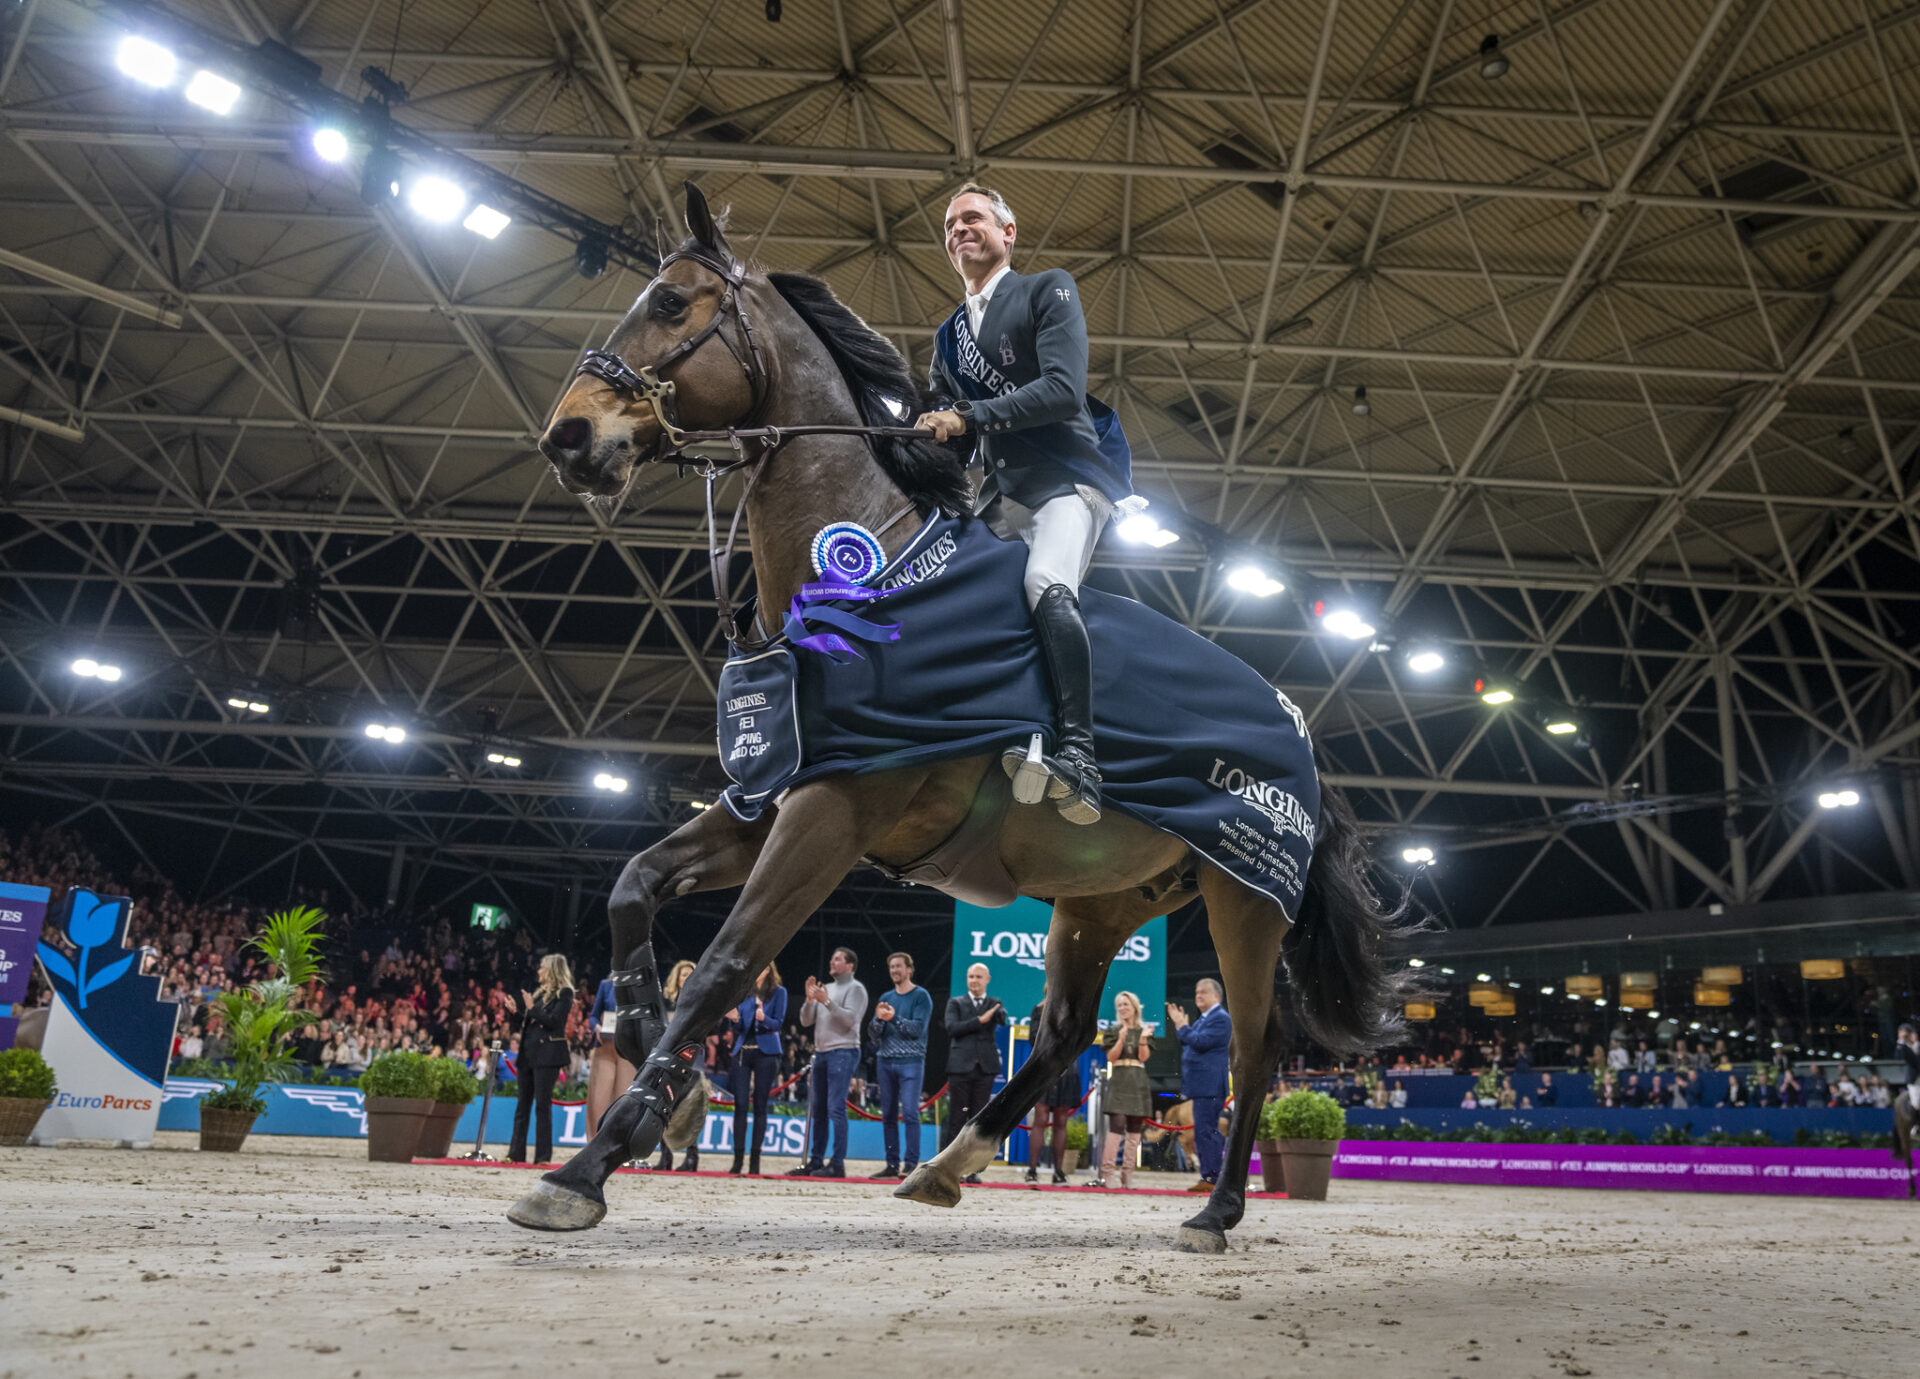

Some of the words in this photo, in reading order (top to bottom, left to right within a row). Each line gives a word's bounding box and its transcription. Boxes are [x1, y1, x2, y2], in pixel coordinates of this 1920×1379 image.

[955, 311, 1018, 396] LONGINES
[869, 529, 957, 604] ONGINES
[802, 588, 824, 596] WORL
[725, 692, 767, 712] LONGINES
[1207, 758, 1315, 851] LONGINES
[1218, 819, 1240, 839] World
[1259, 849, 1294, 880] Amsterdam
[1235, 817, 1265, 843] Longines
[1267, 839, 1279, 852] FEI
[1219, 838, 1256, 865] presented
[1256, 861, 1267, 873] by
[1269, 867, 1286, 883] Euro
[970, 930, 1150, 963] LONES
[57, 1092, 152, 1111] EuroParcs
[1693, 1164, 1754, 1176] LONGINES
[1844, 1167, 1888, 1180] WORLD
